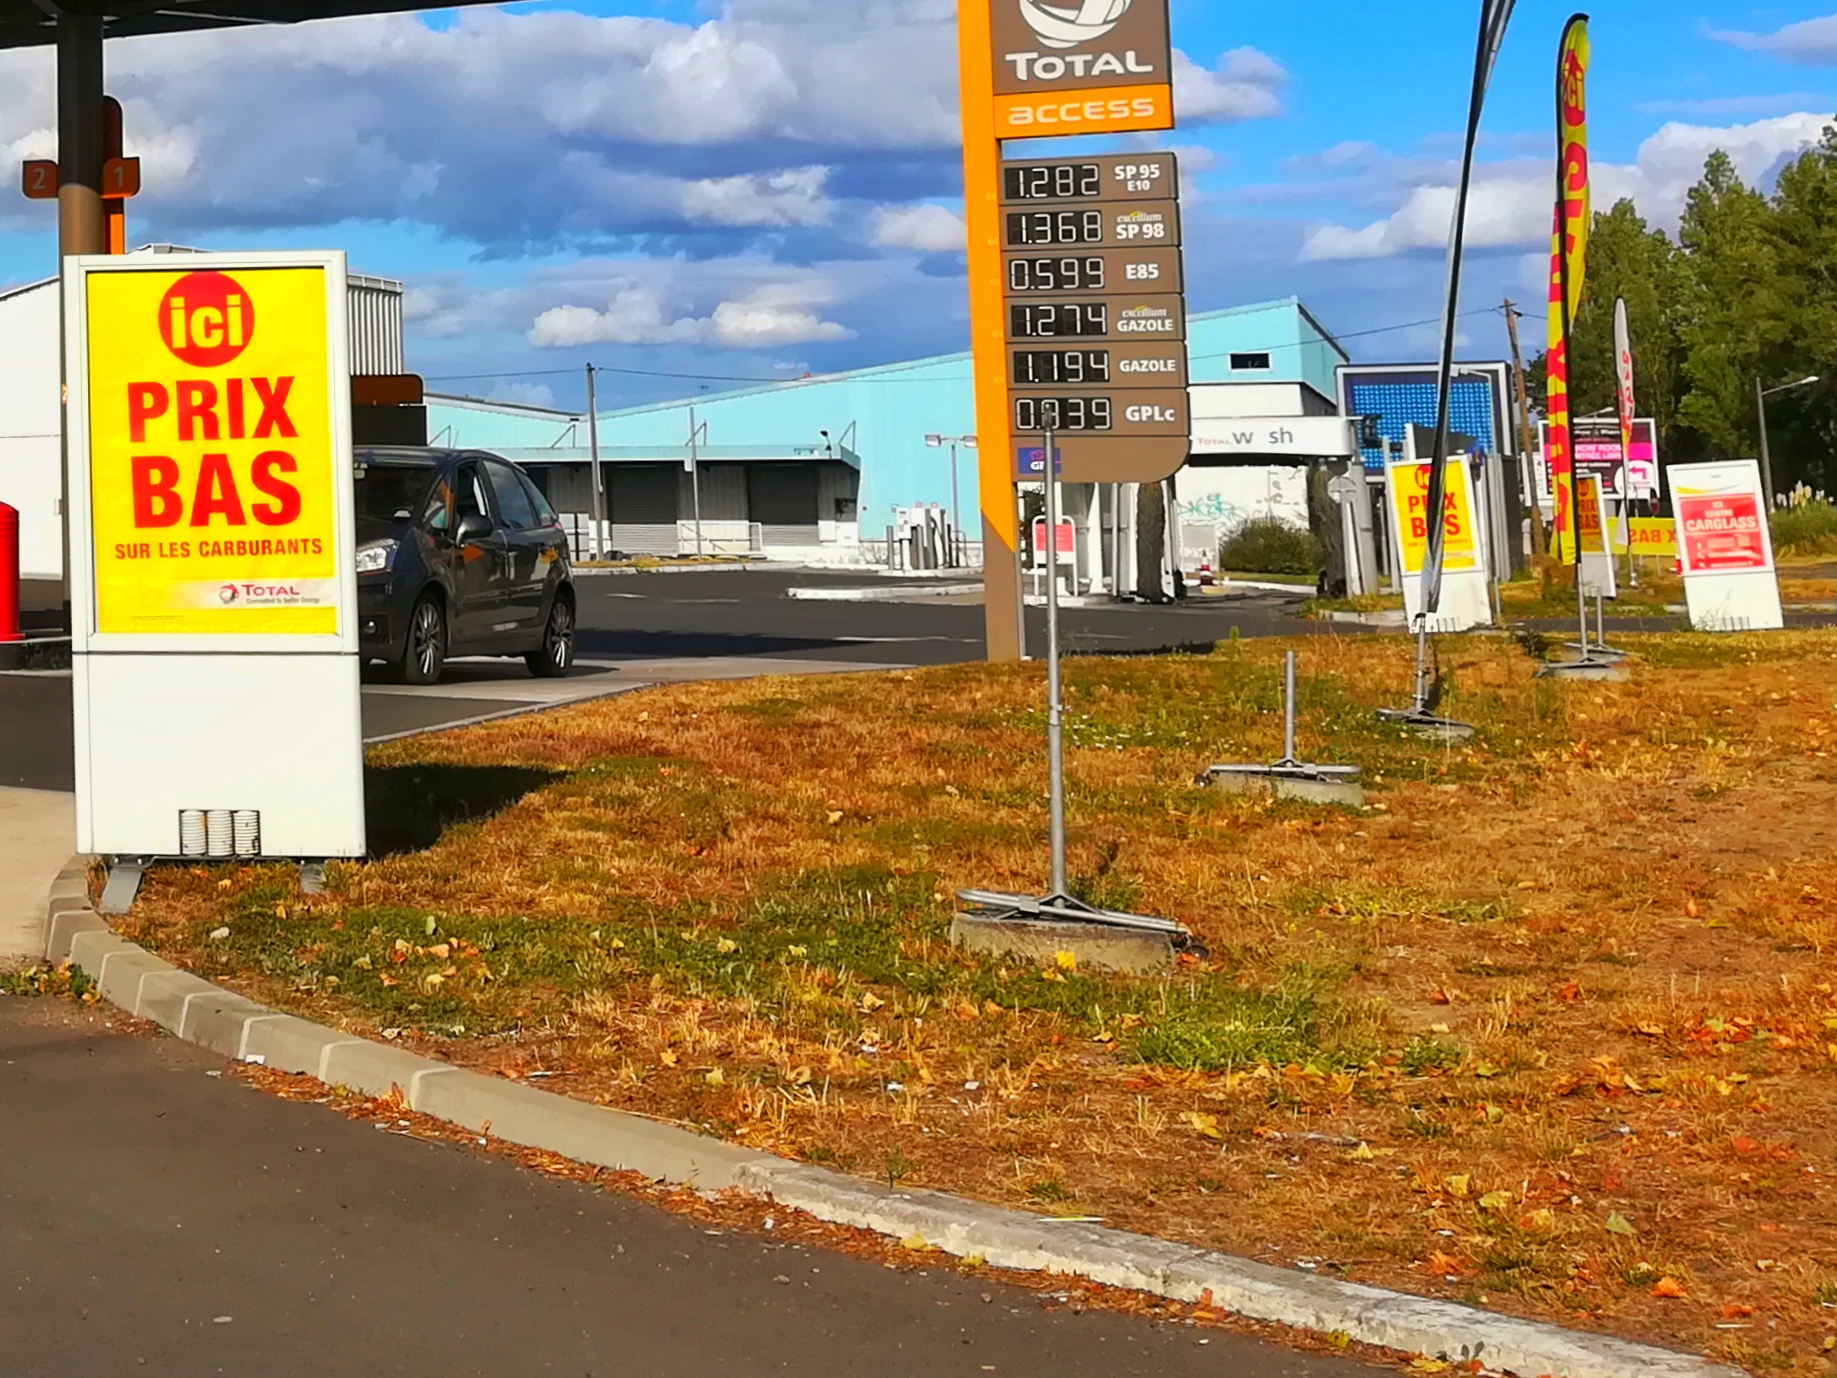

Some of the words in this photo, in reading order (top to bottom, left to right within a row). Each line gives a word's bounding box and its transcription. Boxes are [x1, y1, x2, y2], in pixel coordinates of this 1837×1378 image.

[1005, 51, 1153, 81] TOTAL
[32, 168, 46, 190] 2
[113, 166, 123, 188] 1
[1114, 165, 1137, 180] SP
[1139, 164, 1160, 179] 95
[1127, 180, 1151, 191] E10
[1116, 225, 1140, 239] SP
[1142, 224, 1165, 238] 98
[1126, 264, 1159, 279] E85
[170, 294, 243, 349] ici
[1117, 319, 1174, 333] GAZOLE
[1119, 359, 1176, 373] GAZOLE
[127, 376, 299, 443] PRIX
[1125, 406, 1176, 422] GPLc
[131, 450, 302, 529] BAS
[1408, 492, 1457, 513] PX
[1410, 514, 1461, 538] BS
[1686, 516, 1756, 531] CARGLASS
[115, 543, 150, 559] SUR
[159, 542, 190, 558] LES
[199, 538, 322, 557] CARBURANTS
[242, 584, 300, 596] TOTAL
